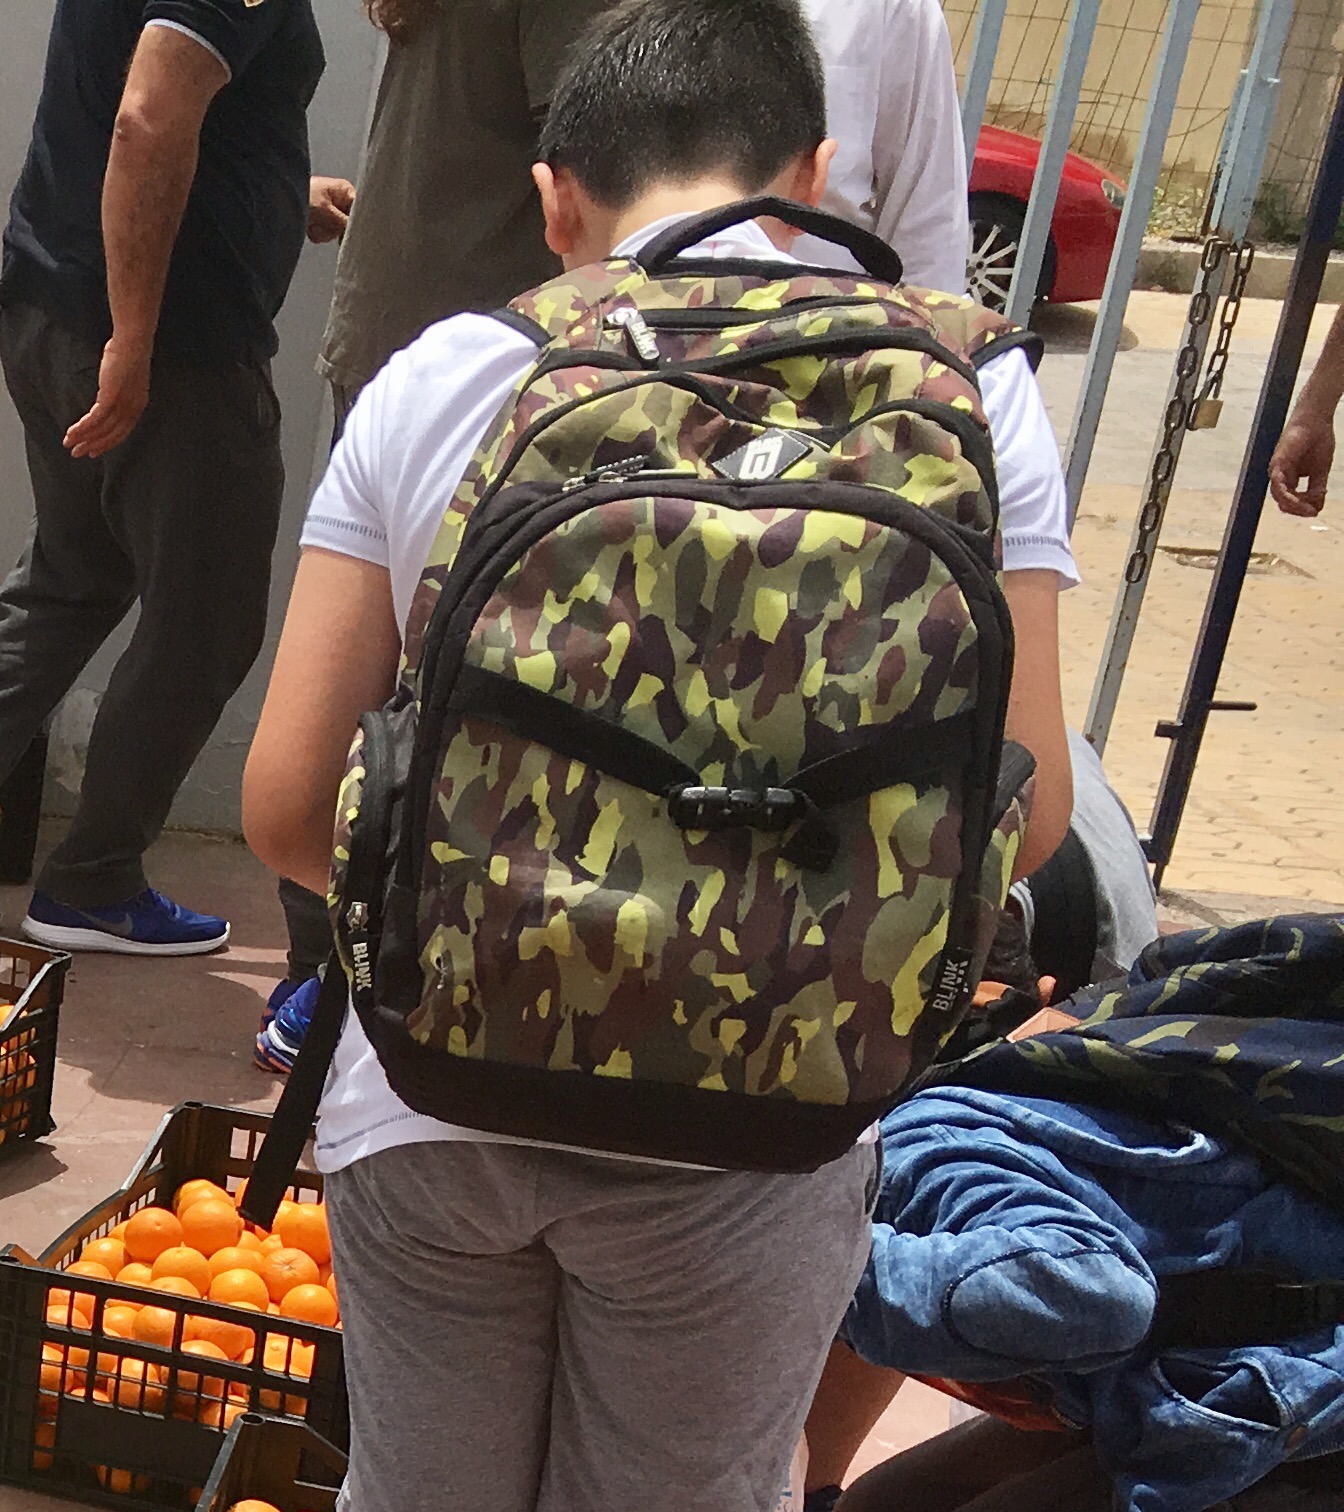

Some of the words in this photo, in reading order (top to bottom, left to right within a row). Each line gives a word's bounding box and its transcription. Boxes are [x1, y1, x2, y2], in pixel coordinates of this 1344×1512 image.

[632, 321, 658, 355] BLINK
[352, 942, 372, 992] BLINK
[932, 959, 959, 1011] BLINK
